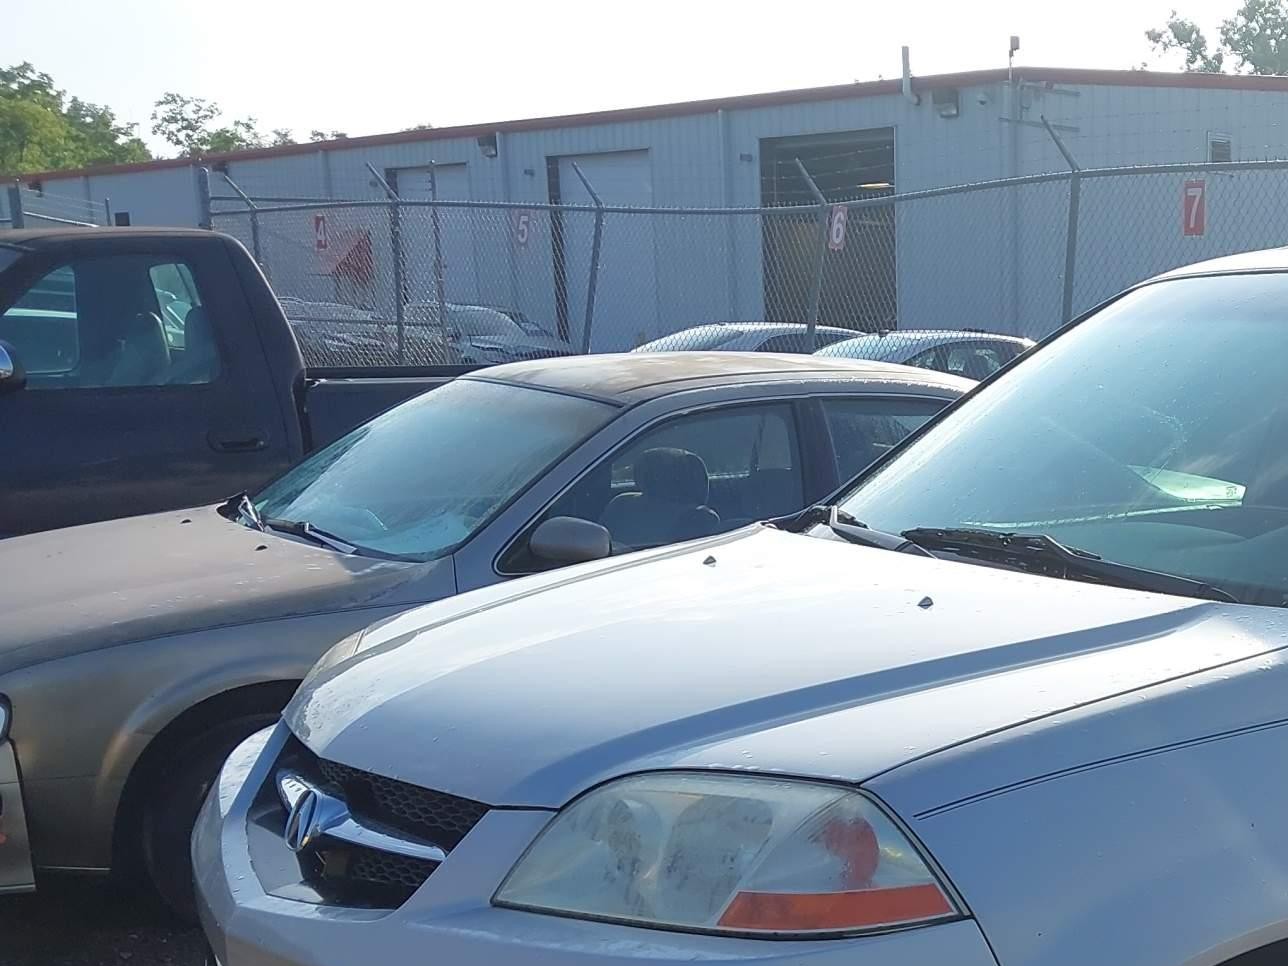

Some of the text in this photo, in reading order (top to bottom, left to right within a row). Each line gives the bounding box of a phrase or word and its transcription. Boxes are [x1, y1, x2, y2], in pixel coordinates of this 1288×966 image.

[1187, 187, 1203, 229] 7
[316, 218, 327, 246] 4
[518, 215, 529, 244] 5
[832, 211, 845, 245] 6
